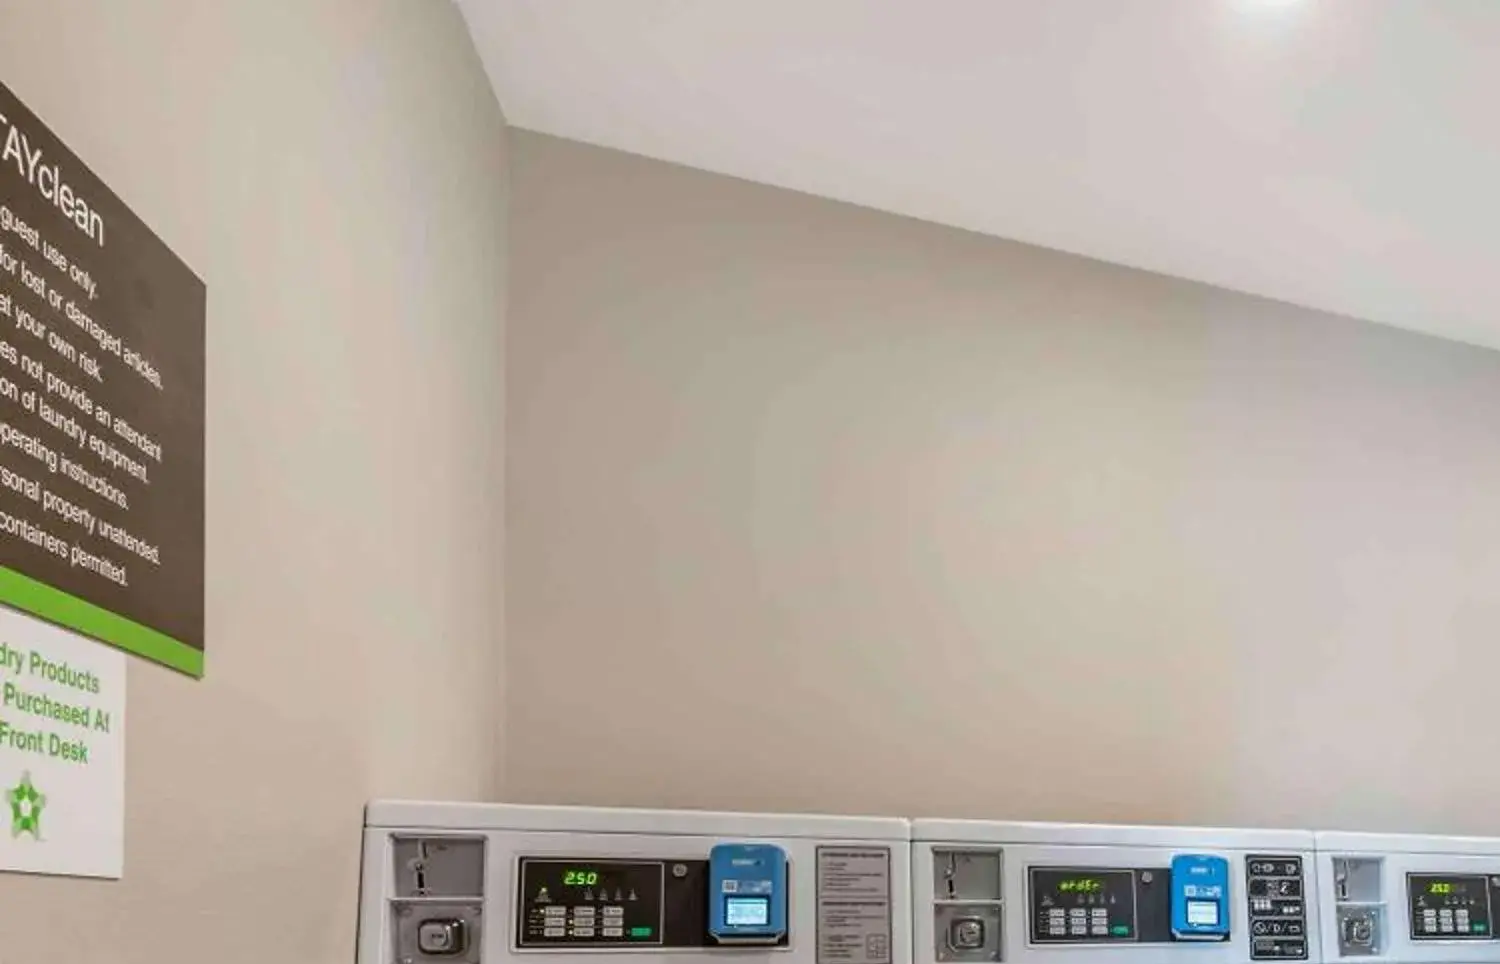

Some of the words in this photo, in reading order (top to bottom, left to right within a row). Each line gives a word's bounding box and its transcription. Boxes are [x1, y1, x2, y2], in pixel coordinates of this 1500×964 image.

[1, 205, 39, 250] guest
[43, 240, 67, 272] use
[15, 305, 46, 339] your
[48, 331, 76, 363] own
[21, 261, 46, 299] lost
[49, 289, 63, 309] or
[65, 301, 121, 356] damaged
[21, 354, 43, 383] not
[46, 371, 93, 415] provide
[95, 406, 111, 429] an
[113, 417, 162, 463] attendant
[22, 391, 35, 413] of
[39, 397, 86, 449] laundry
[0, 423, 58, 473] perating
[61, 452, 129, 510] instructions.
[43, 490, 95, 536] property
[30, 650, 100, 694] Products
[3, 681, 90, 728] Purchased
[94, 709, 110, 734] At
[0, 719, 44, 753] Front
[49, 732, 88, 764] Desk
[564, 871, 598, 885] 250
